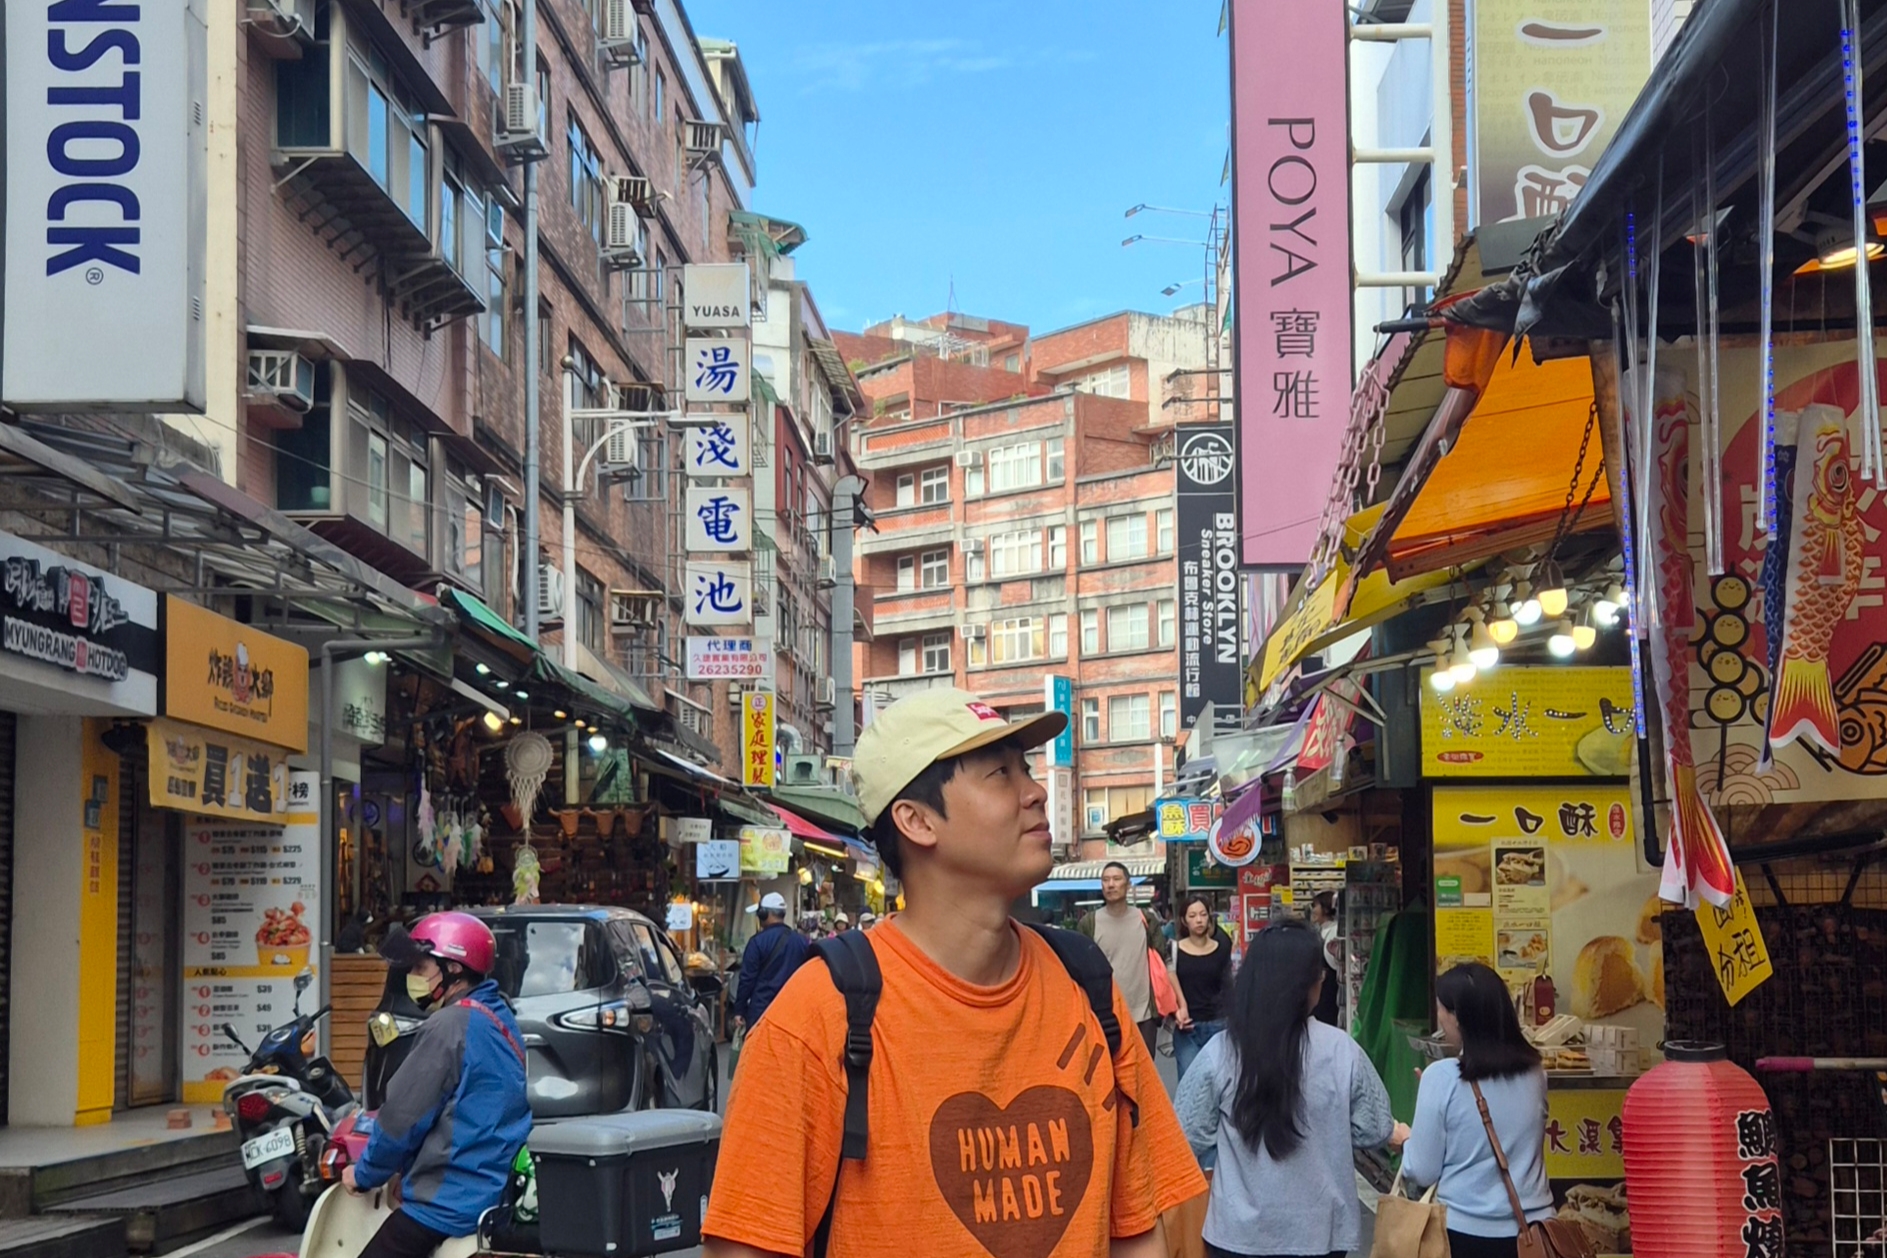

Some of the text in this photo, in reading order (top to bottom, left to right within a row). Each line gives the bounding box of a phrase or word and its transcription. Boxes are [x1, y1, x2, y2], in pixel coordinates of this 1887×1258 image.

[1267, 117, 1318, 288] POYA
[692, 305, 740, 317] YUASA
[1269, 307, 1321, 419] 寶雅
[695, 346, 743, 616] 湯淺電池
[1201, 528, 1214, 646] Sneaker Store
[1215, 512, 1237, 664] BROOKLYN
[3, 619, 76, 664] MYUNGRANG
[87, 645, 127, 678] HOTDOG
[698, 664, 762, 676] 26235290
[707, 639, 752, 652] 代理商
[1459, 802, 1600, 838] 一口酥
[957, 1117, 1071, 1173] HUMAN
[973, 1170, 1064, 1224] MADE
